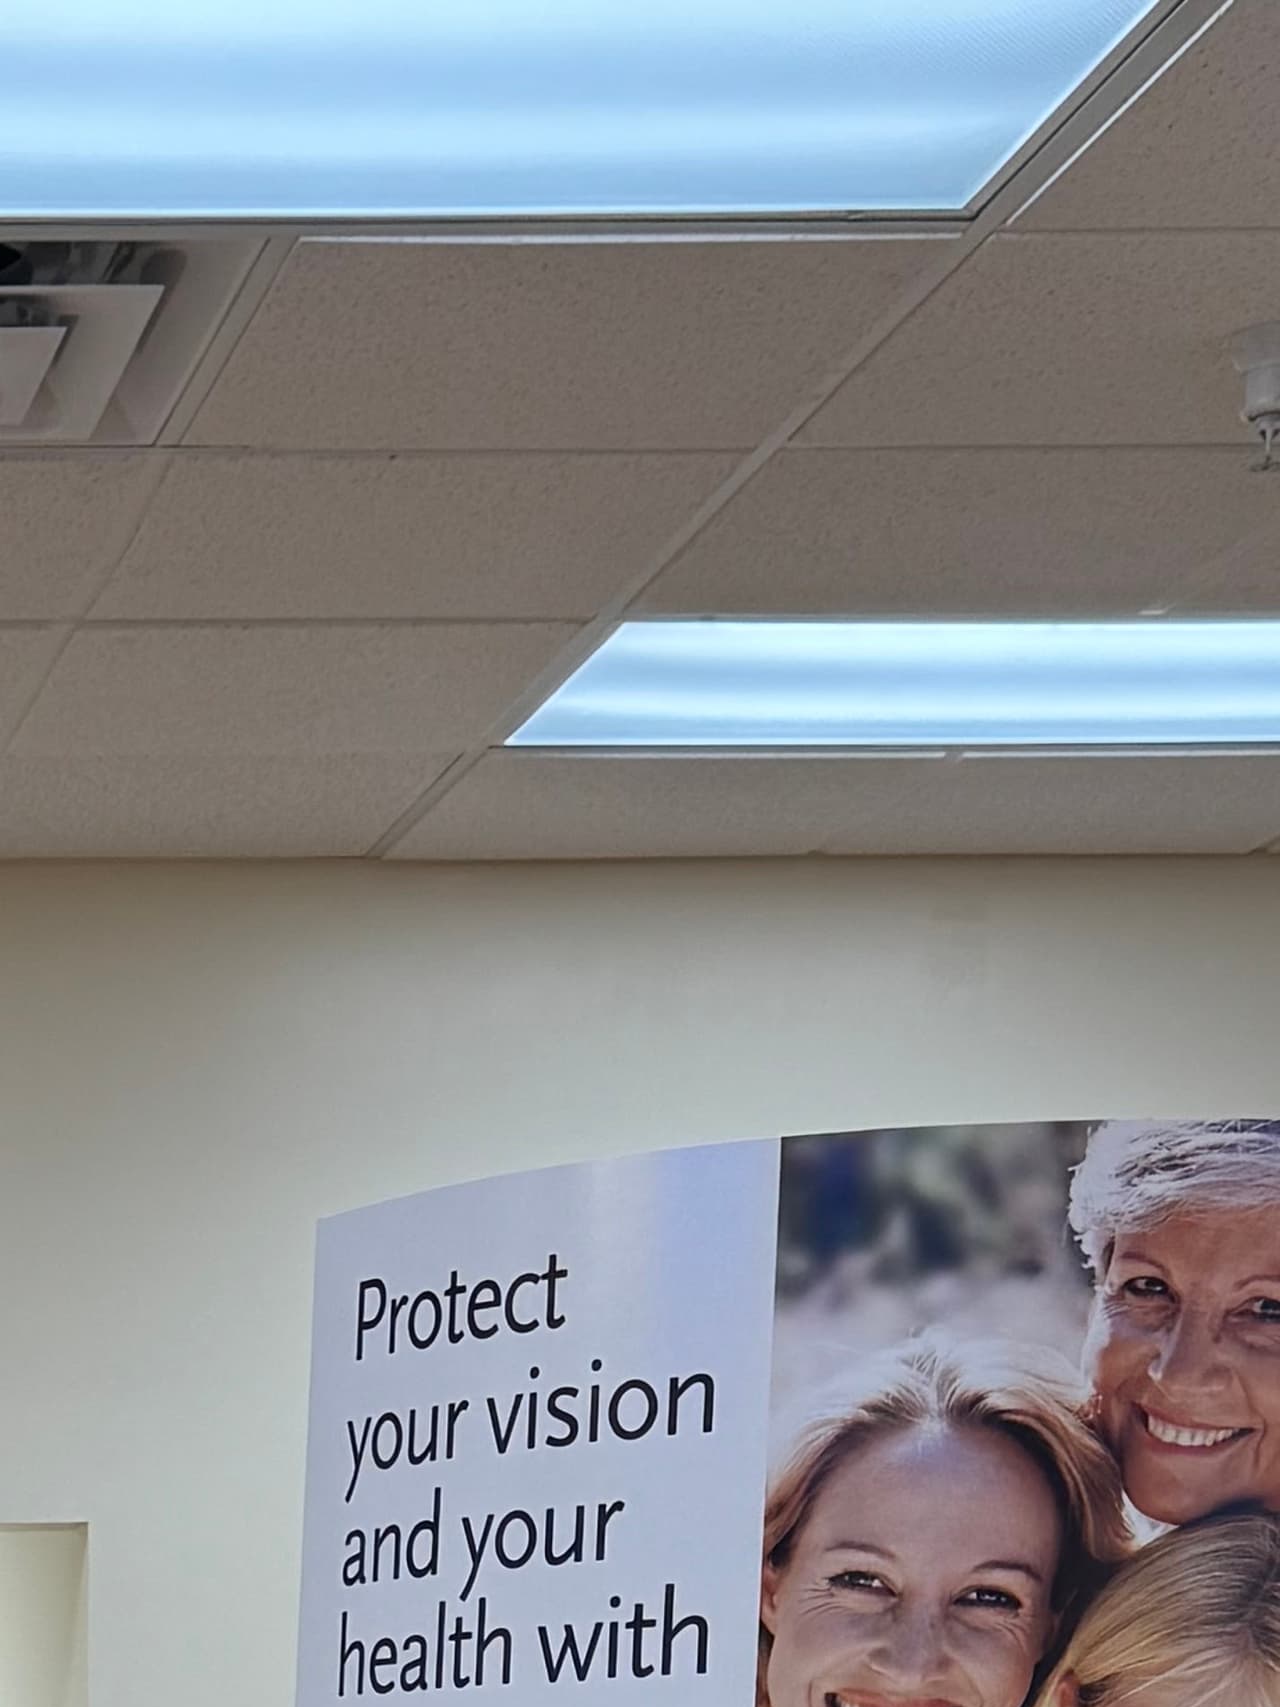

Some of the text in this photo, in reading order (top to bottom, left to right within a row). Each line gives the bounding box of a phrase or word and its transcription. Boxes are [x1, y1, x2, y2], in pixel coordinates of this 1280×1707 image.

[355, 1253, 568, 1361] Protect
[345, 1361, 716, 1502] your vision
[340, 1486, 623, 1601] and your
[338, 1585, 710, 1697] health with
